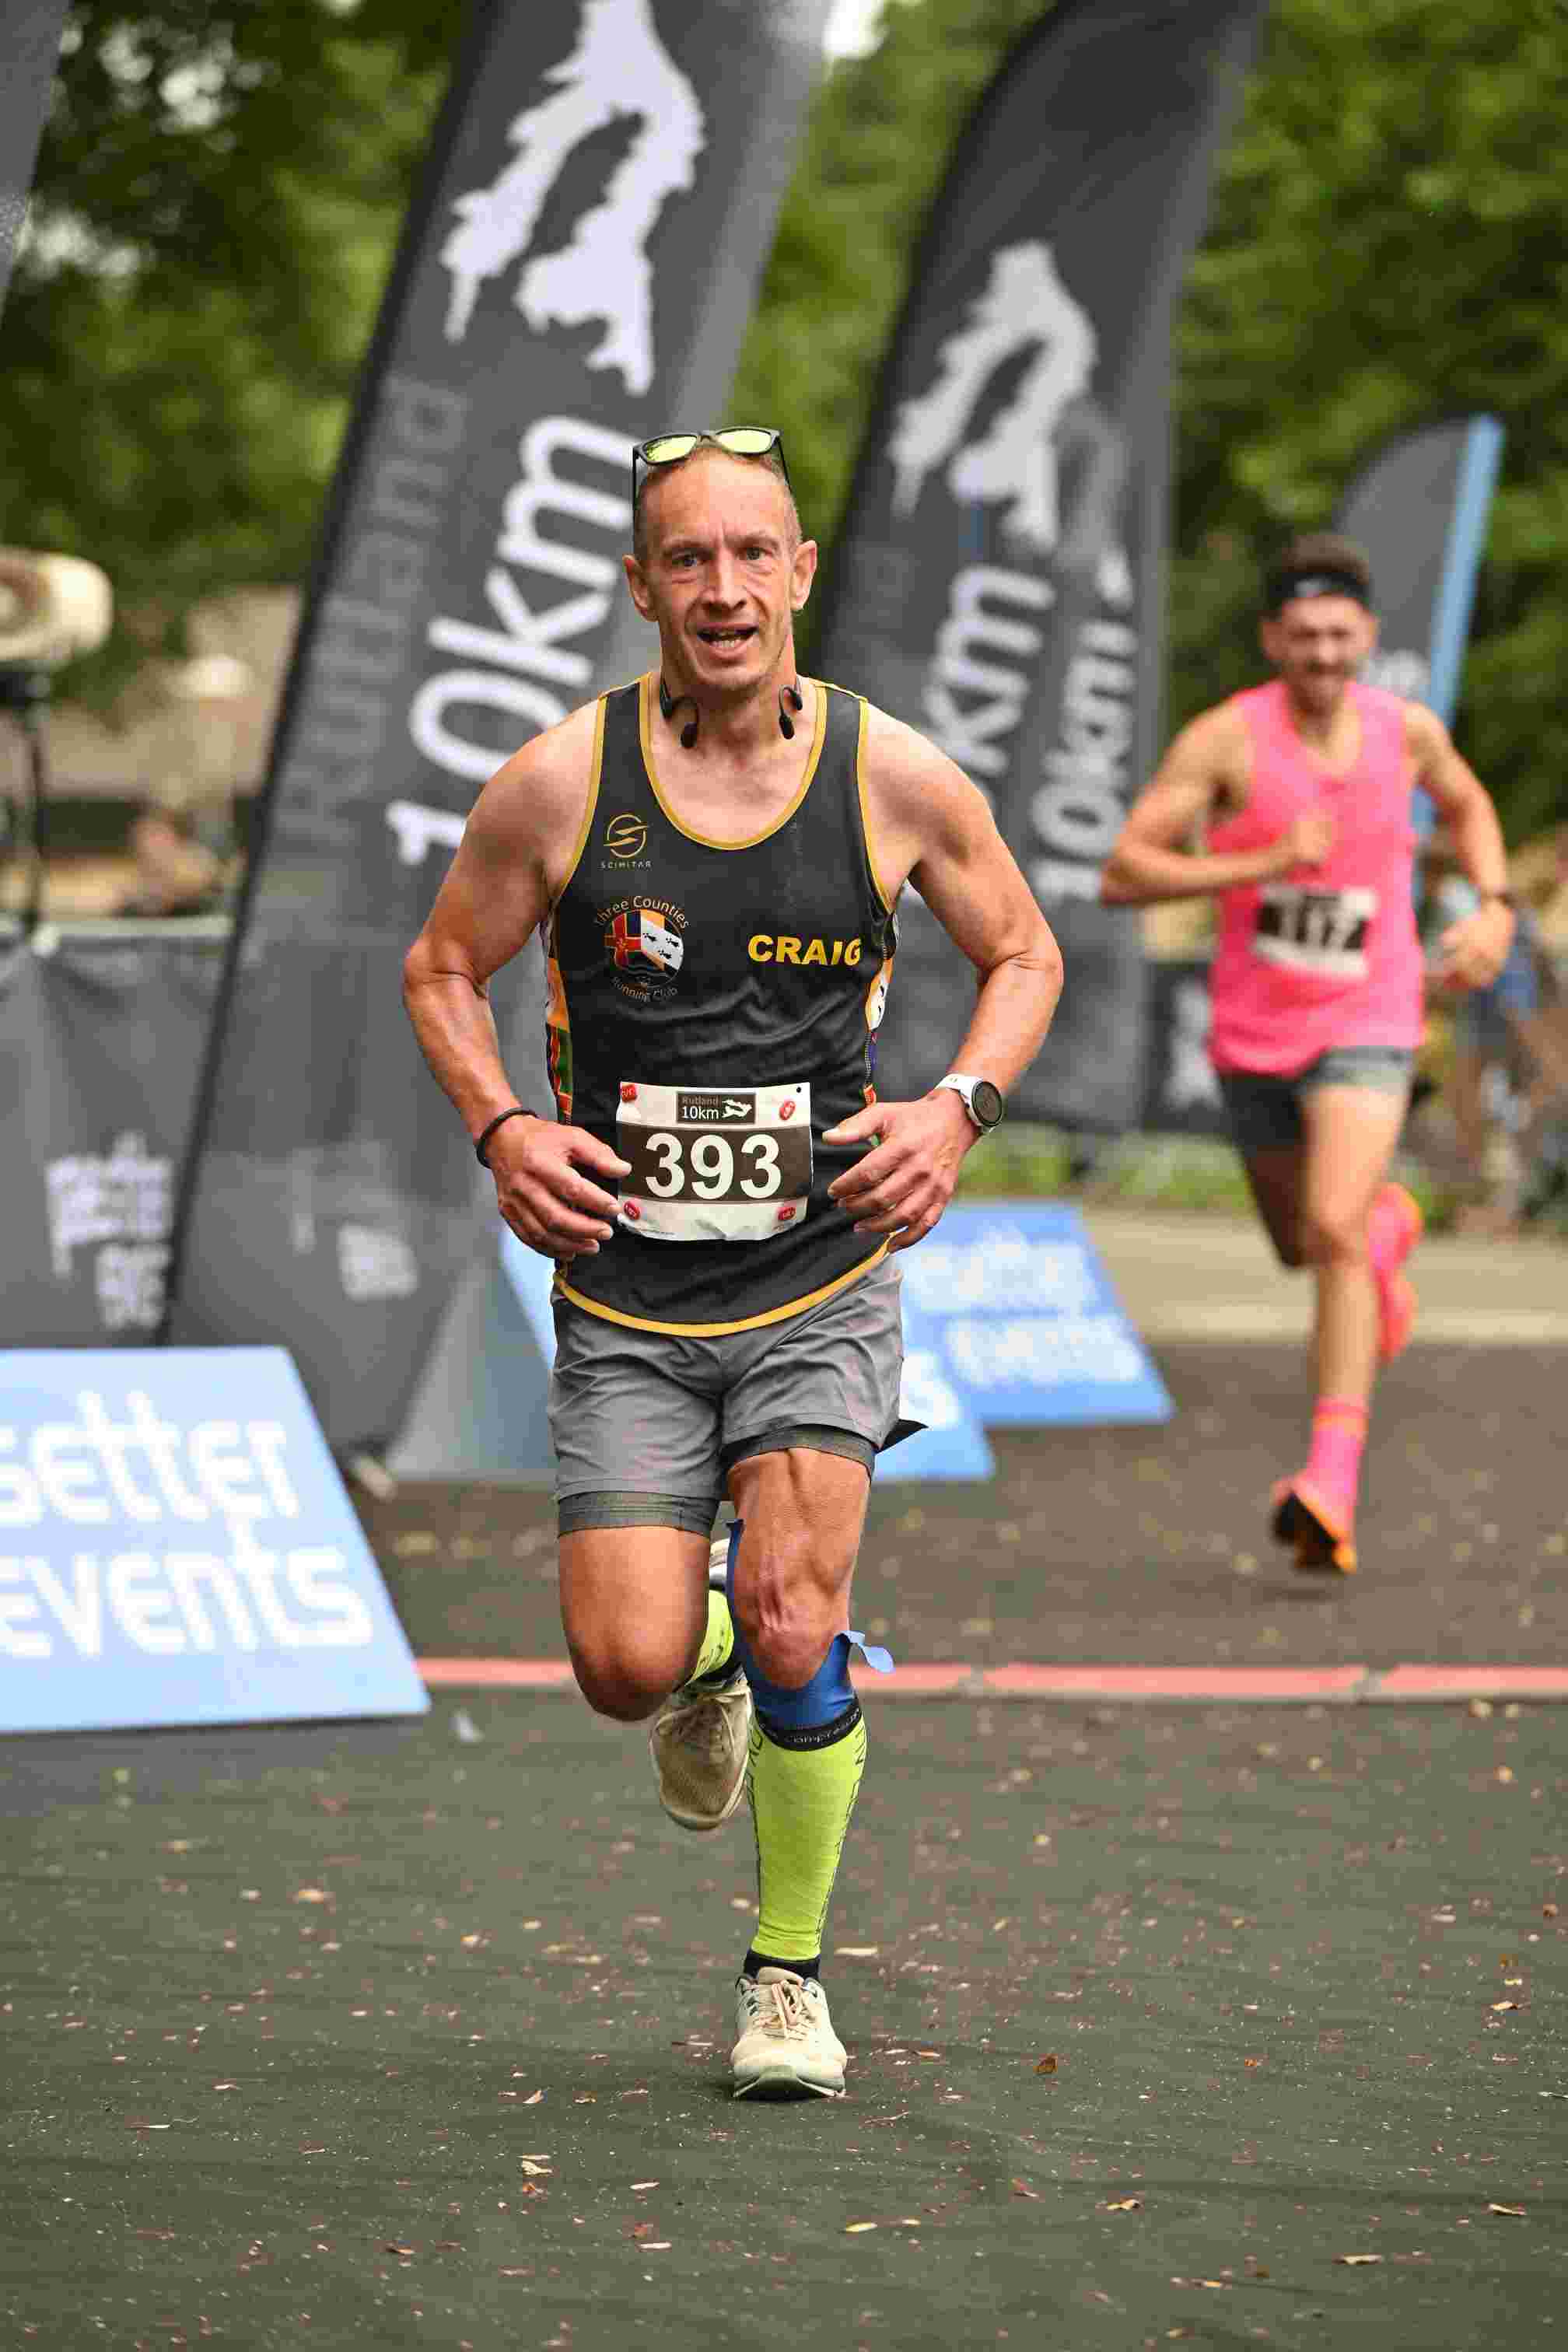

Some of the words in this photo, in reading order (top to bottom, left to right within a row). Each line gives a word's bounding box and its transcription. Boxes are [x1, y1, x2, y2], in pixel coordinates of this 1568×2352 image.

[387, 414, 636, 866] 10km
[915, 563, 1056, 778] km
[600, 860, 653, 870] SCIMITAR
[594, 900, 630, 927] Three
[632, 894, 691, 929] Counties
[747, 934, 862, 966] CRAIG
[681, 1106, 719, 1120] 10km
[682, 1094, 719, 1105] Rutland
[645, 1132, 782, 1200] 393
